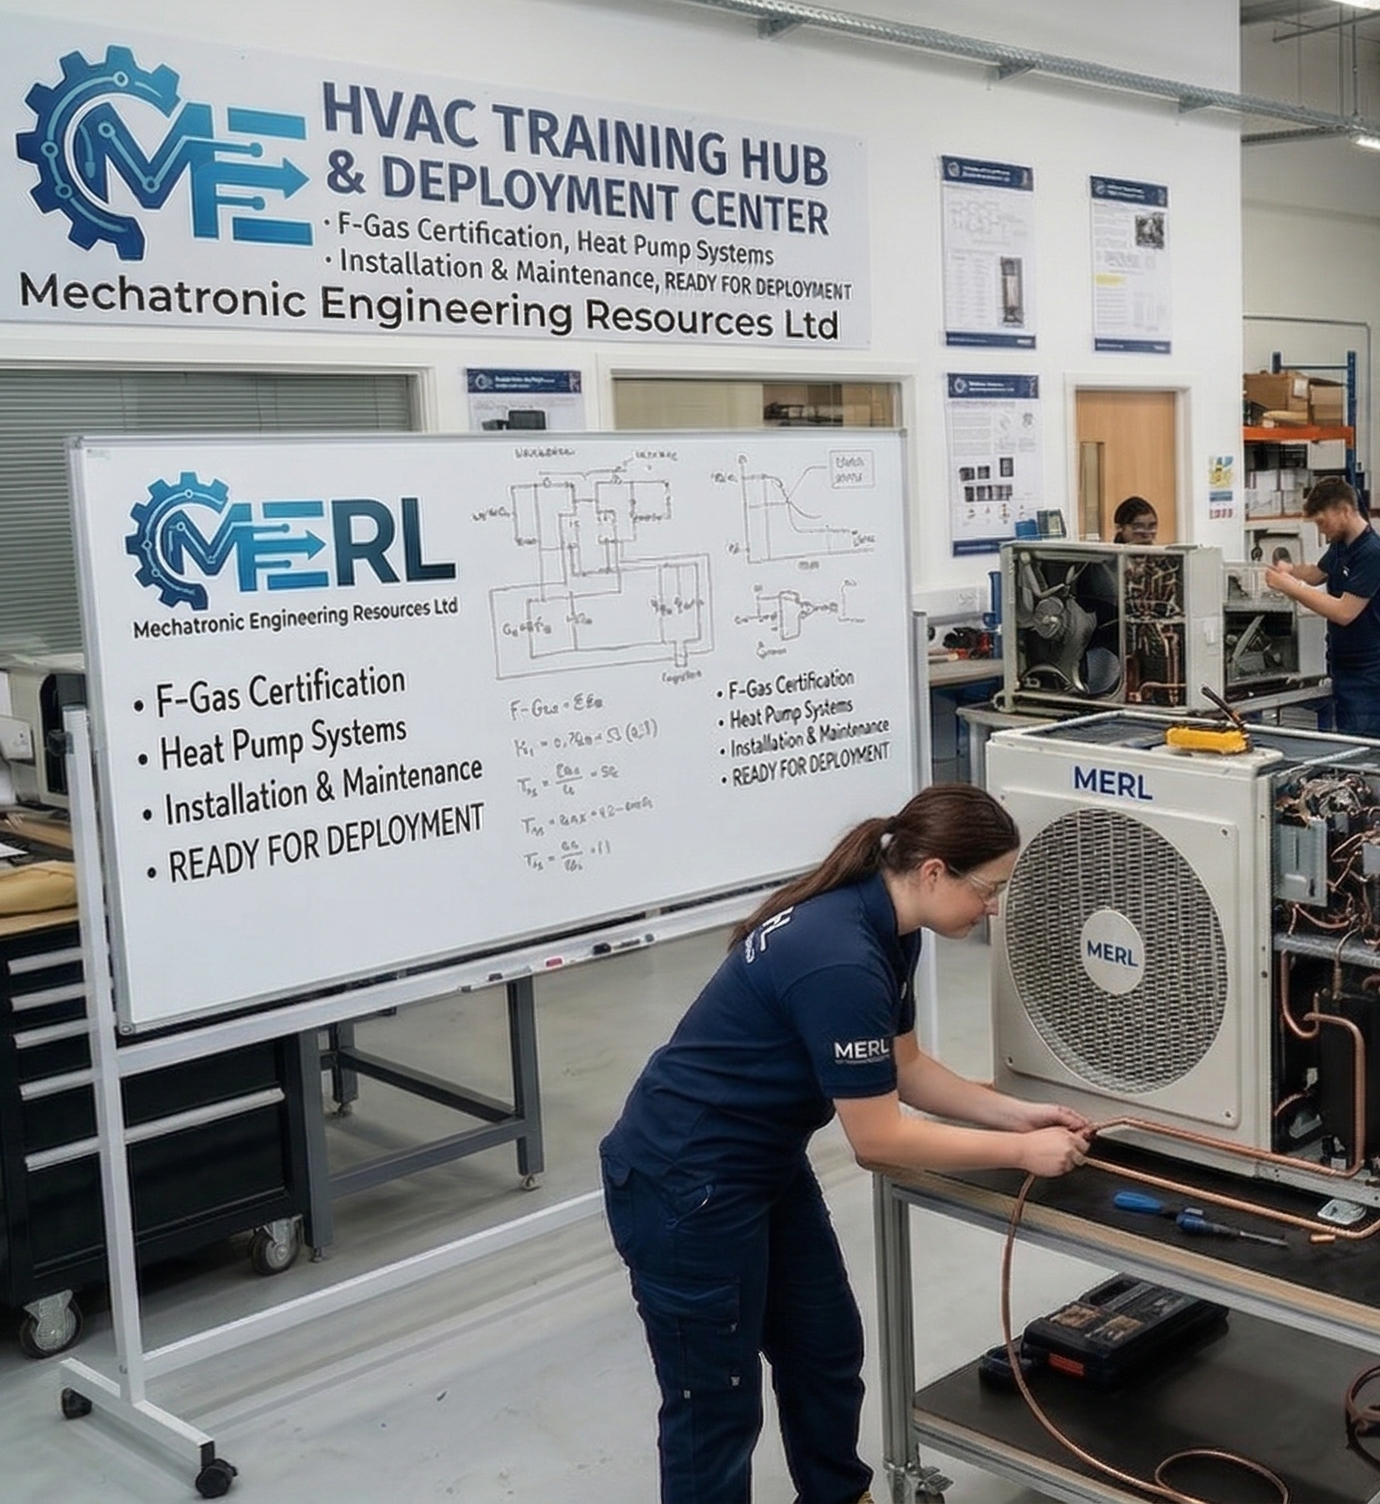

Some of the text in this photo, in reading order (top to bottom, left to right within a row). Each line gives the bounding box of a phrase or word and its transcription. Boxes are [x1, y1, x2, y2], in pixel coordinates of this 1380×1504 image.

[323, 81, 828, 187] HVAC TRAINING HUB
[326, 149, 829, 236] & DEPLOYMENT CENTER
[338, 211, 775, 267] F-Gas Certification, Heat Pump Systems
[340, 248, 853, 300] Installation & Maintenance, READY FOR DEPLOYMENT
[20, 271, 839, 340] Mechatronic Engineering Resources Ltd
[161, 497, 457, 592] MERL
[133, 597, 459, 639] Mechatronic Engineering Resources Ltd
[156, 666, 406, 718] F-Gas Certification
[728, 668, 855, 700] F-Gas Certification
[730, 709, 762, 729] Heat
[765, 704, 801, 726] Pump
[806, 726, 817, 745] &
[161, 718, 407, 770] Heat Pump Systems
[732, 741, 891, 787] READY FOR DEPLOYMENT
[166, 779, 308, 825] Installation
[316, 770, 336, 802] &
[343, 757, 484, 798] Maintenance
[1074, 765, 1153, 801] MERL
[169, 839, 260, 883] READY
[268, 828, 320, 866] FOR
[327, 802, 485, 856] DEPLOYMENT
[1087, 940, 1139, 968] MERL
[834, 1038, 890, 1059] MERL
